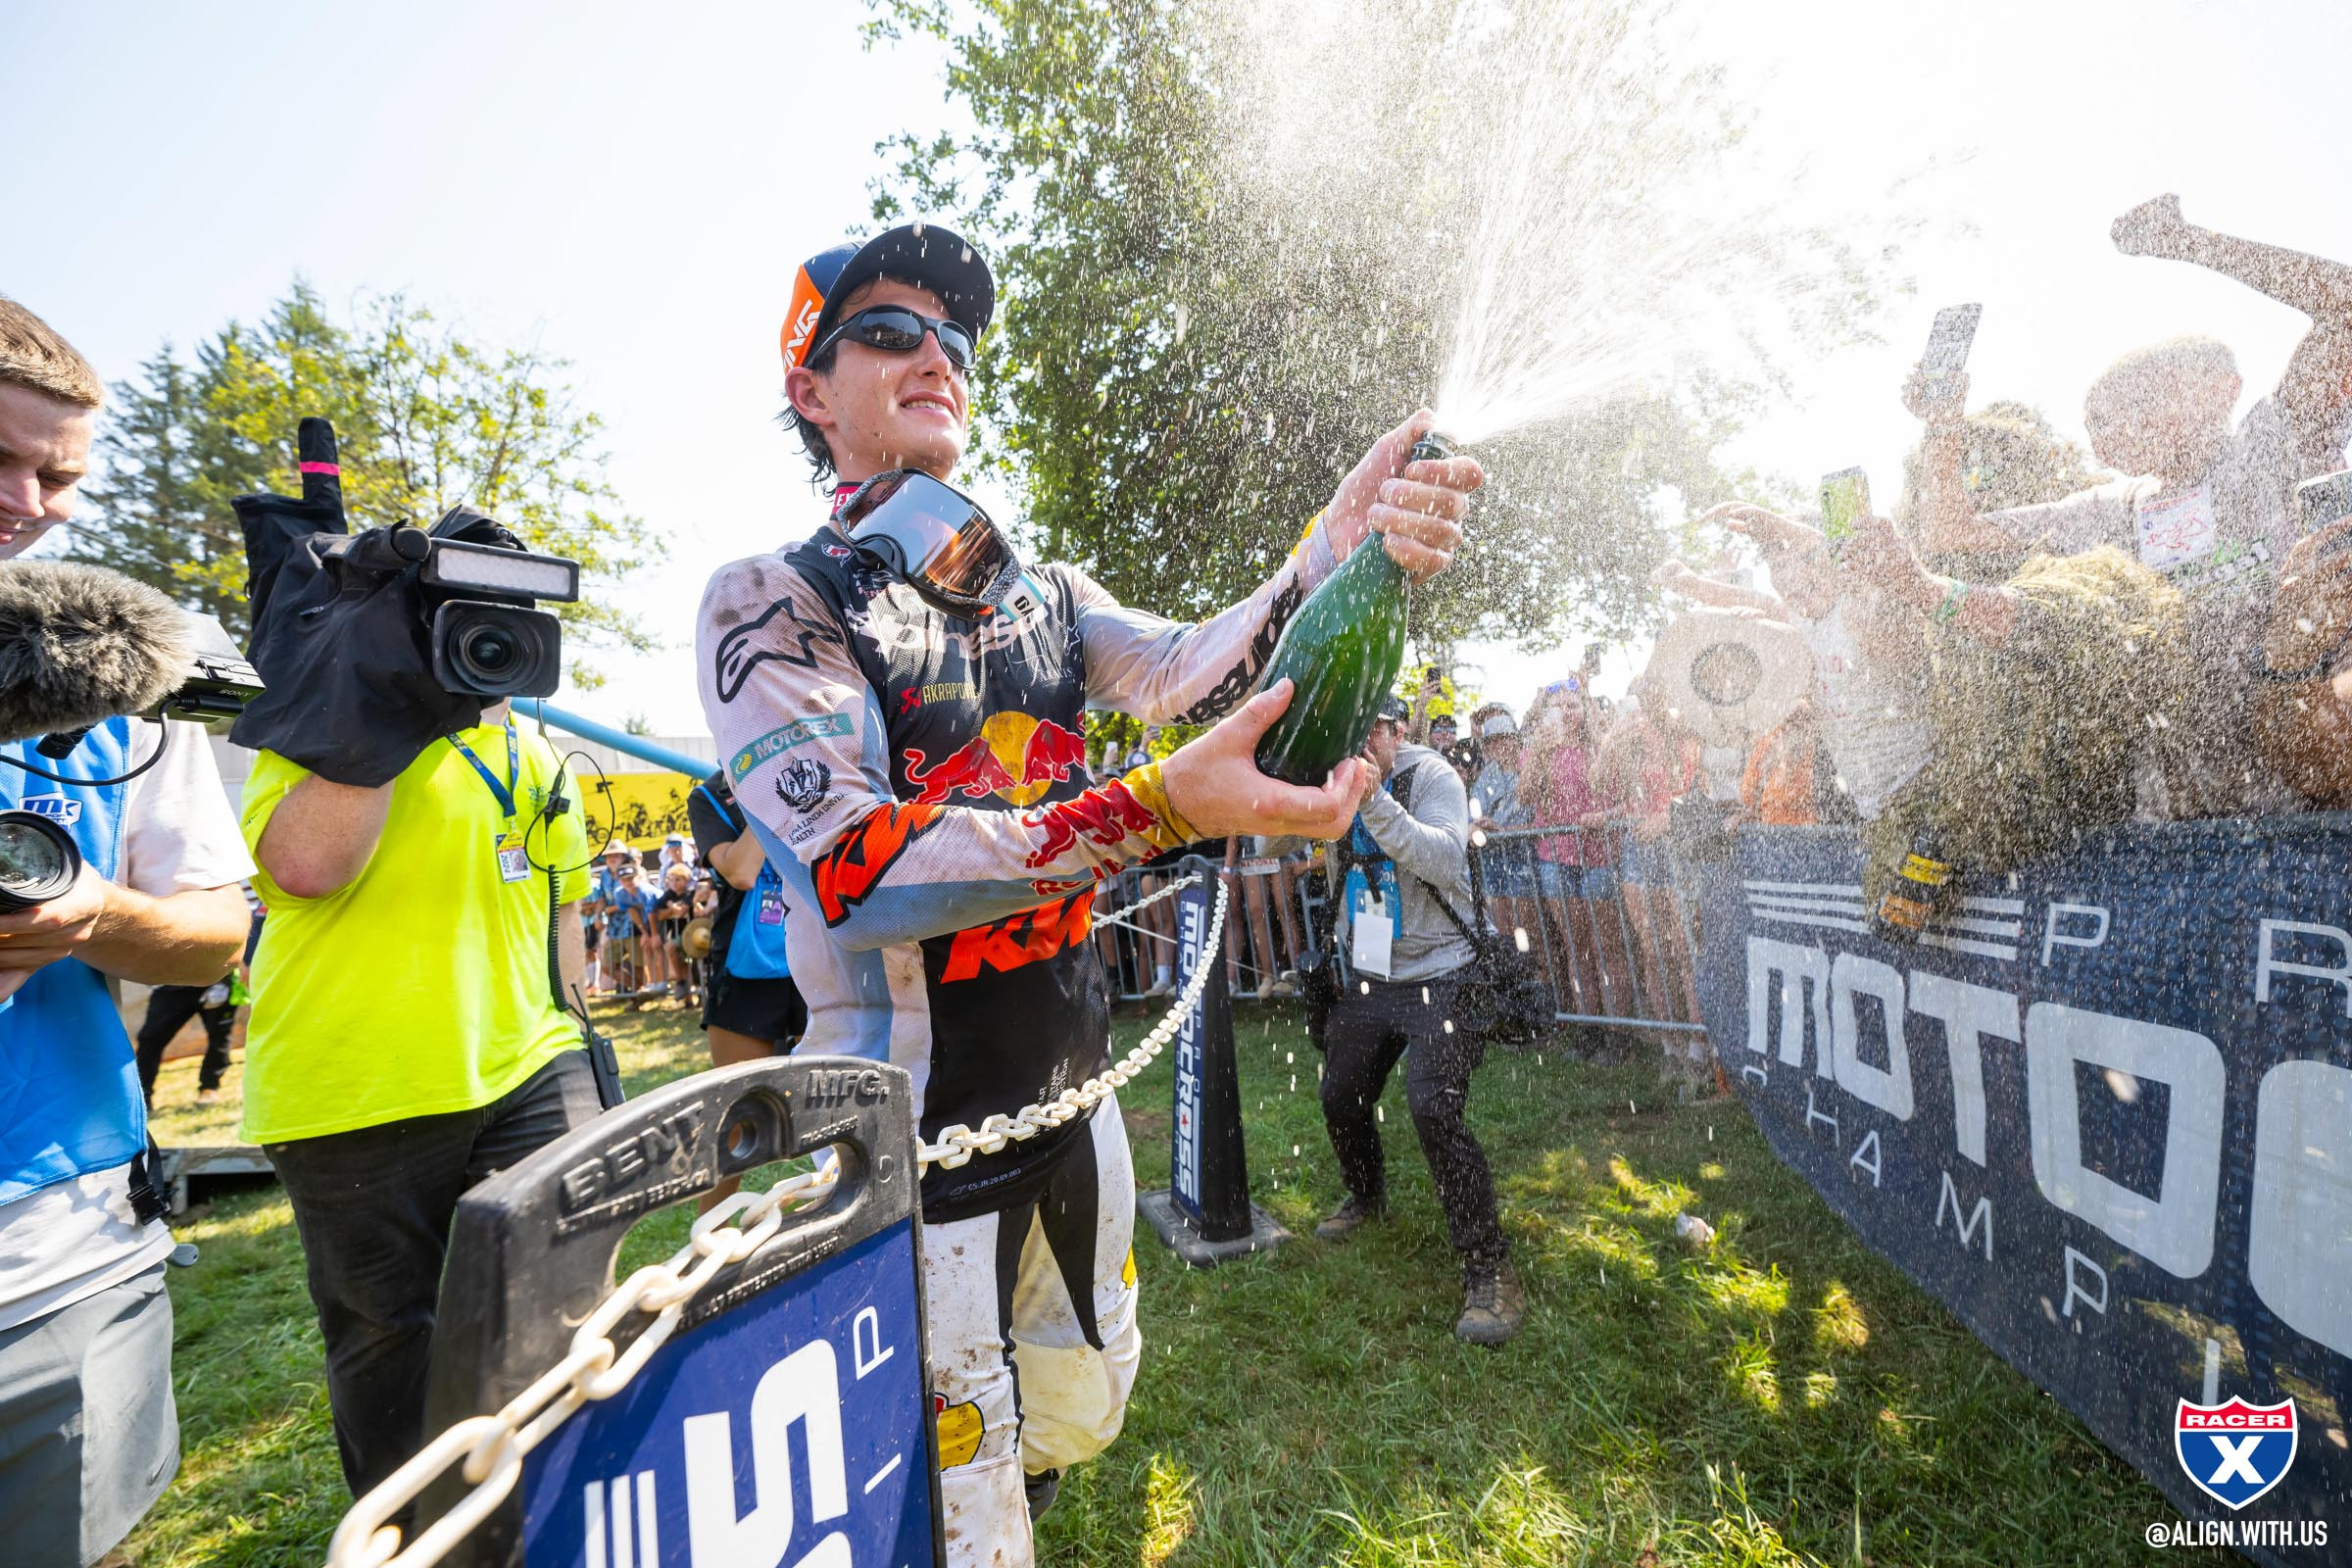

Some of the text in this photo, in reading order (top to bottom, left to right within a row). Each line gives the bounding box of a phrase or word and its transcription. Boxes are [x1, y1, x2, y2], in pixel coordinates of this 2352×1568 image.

[754, 718, 843, 760] MOTOREX
[791, 827, 816, 846] EALTH
[1179, 901, 1200, 1201] MOOCROSS
[561, 1100, 706, 1202] BENT
[808, 1069, 891, 1100] MFG.
